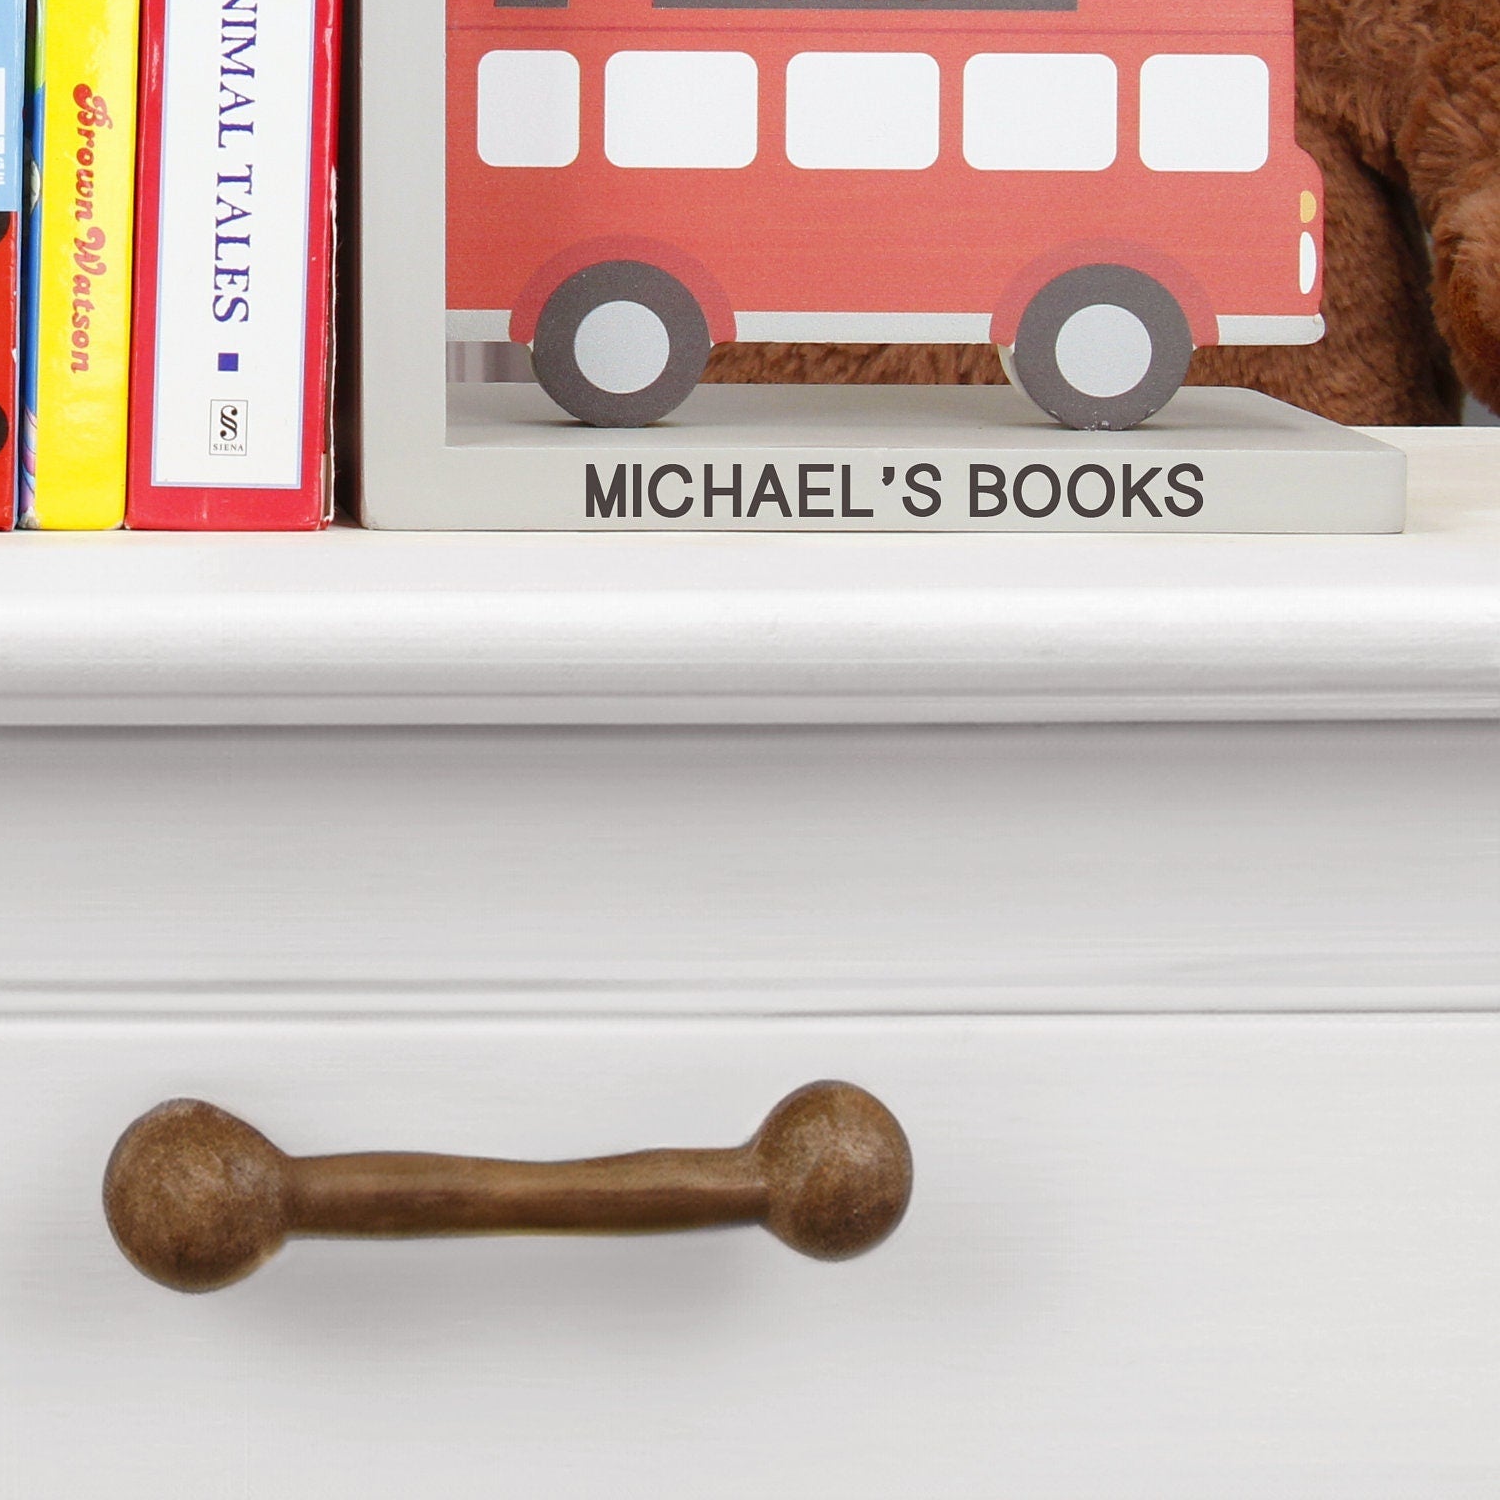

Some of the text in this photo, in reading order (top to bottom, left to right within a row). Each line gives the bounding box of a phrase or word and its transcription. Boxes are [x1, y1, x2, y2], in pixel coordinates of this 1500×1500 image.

[71, 83, 113, 374] Brown Watson
[212, 163, 253, 324] TALES
[212, 443, 244, 452] SIENA
[585, 463, 1204, 519] MICHAEL'S BOOKS
